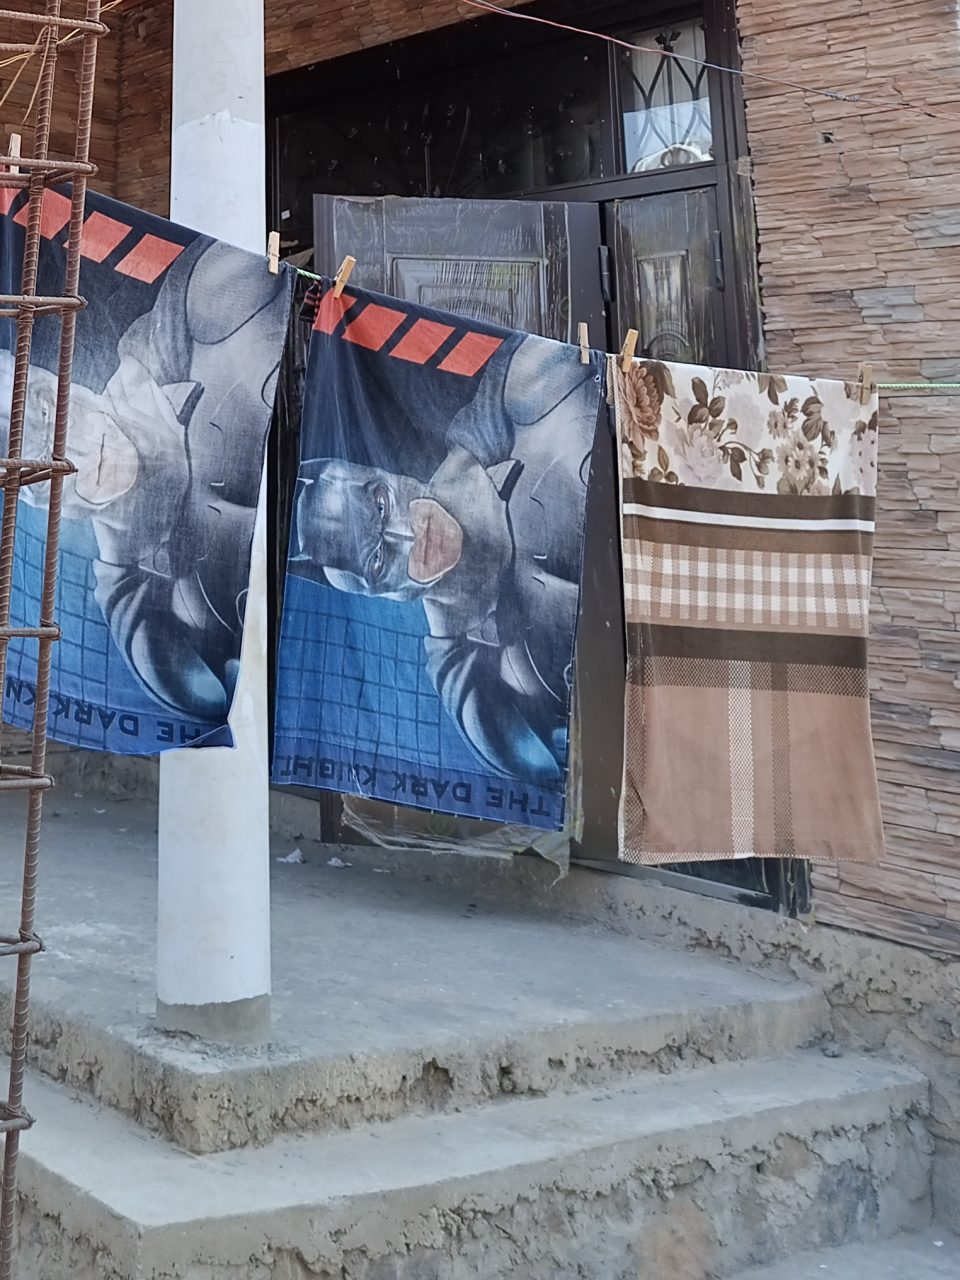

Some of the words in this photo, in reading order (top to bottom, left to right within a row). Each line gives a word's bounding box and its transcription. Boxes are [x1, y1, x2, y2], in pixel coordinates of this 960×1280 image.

[53, 693, 140, 737] DARK
[156, 720, 202, 744] HE
[280, 753, 378, 787] KNIGHT
[392, 775, 472, 804] DARK
[486, 785, 551, 817] THE
